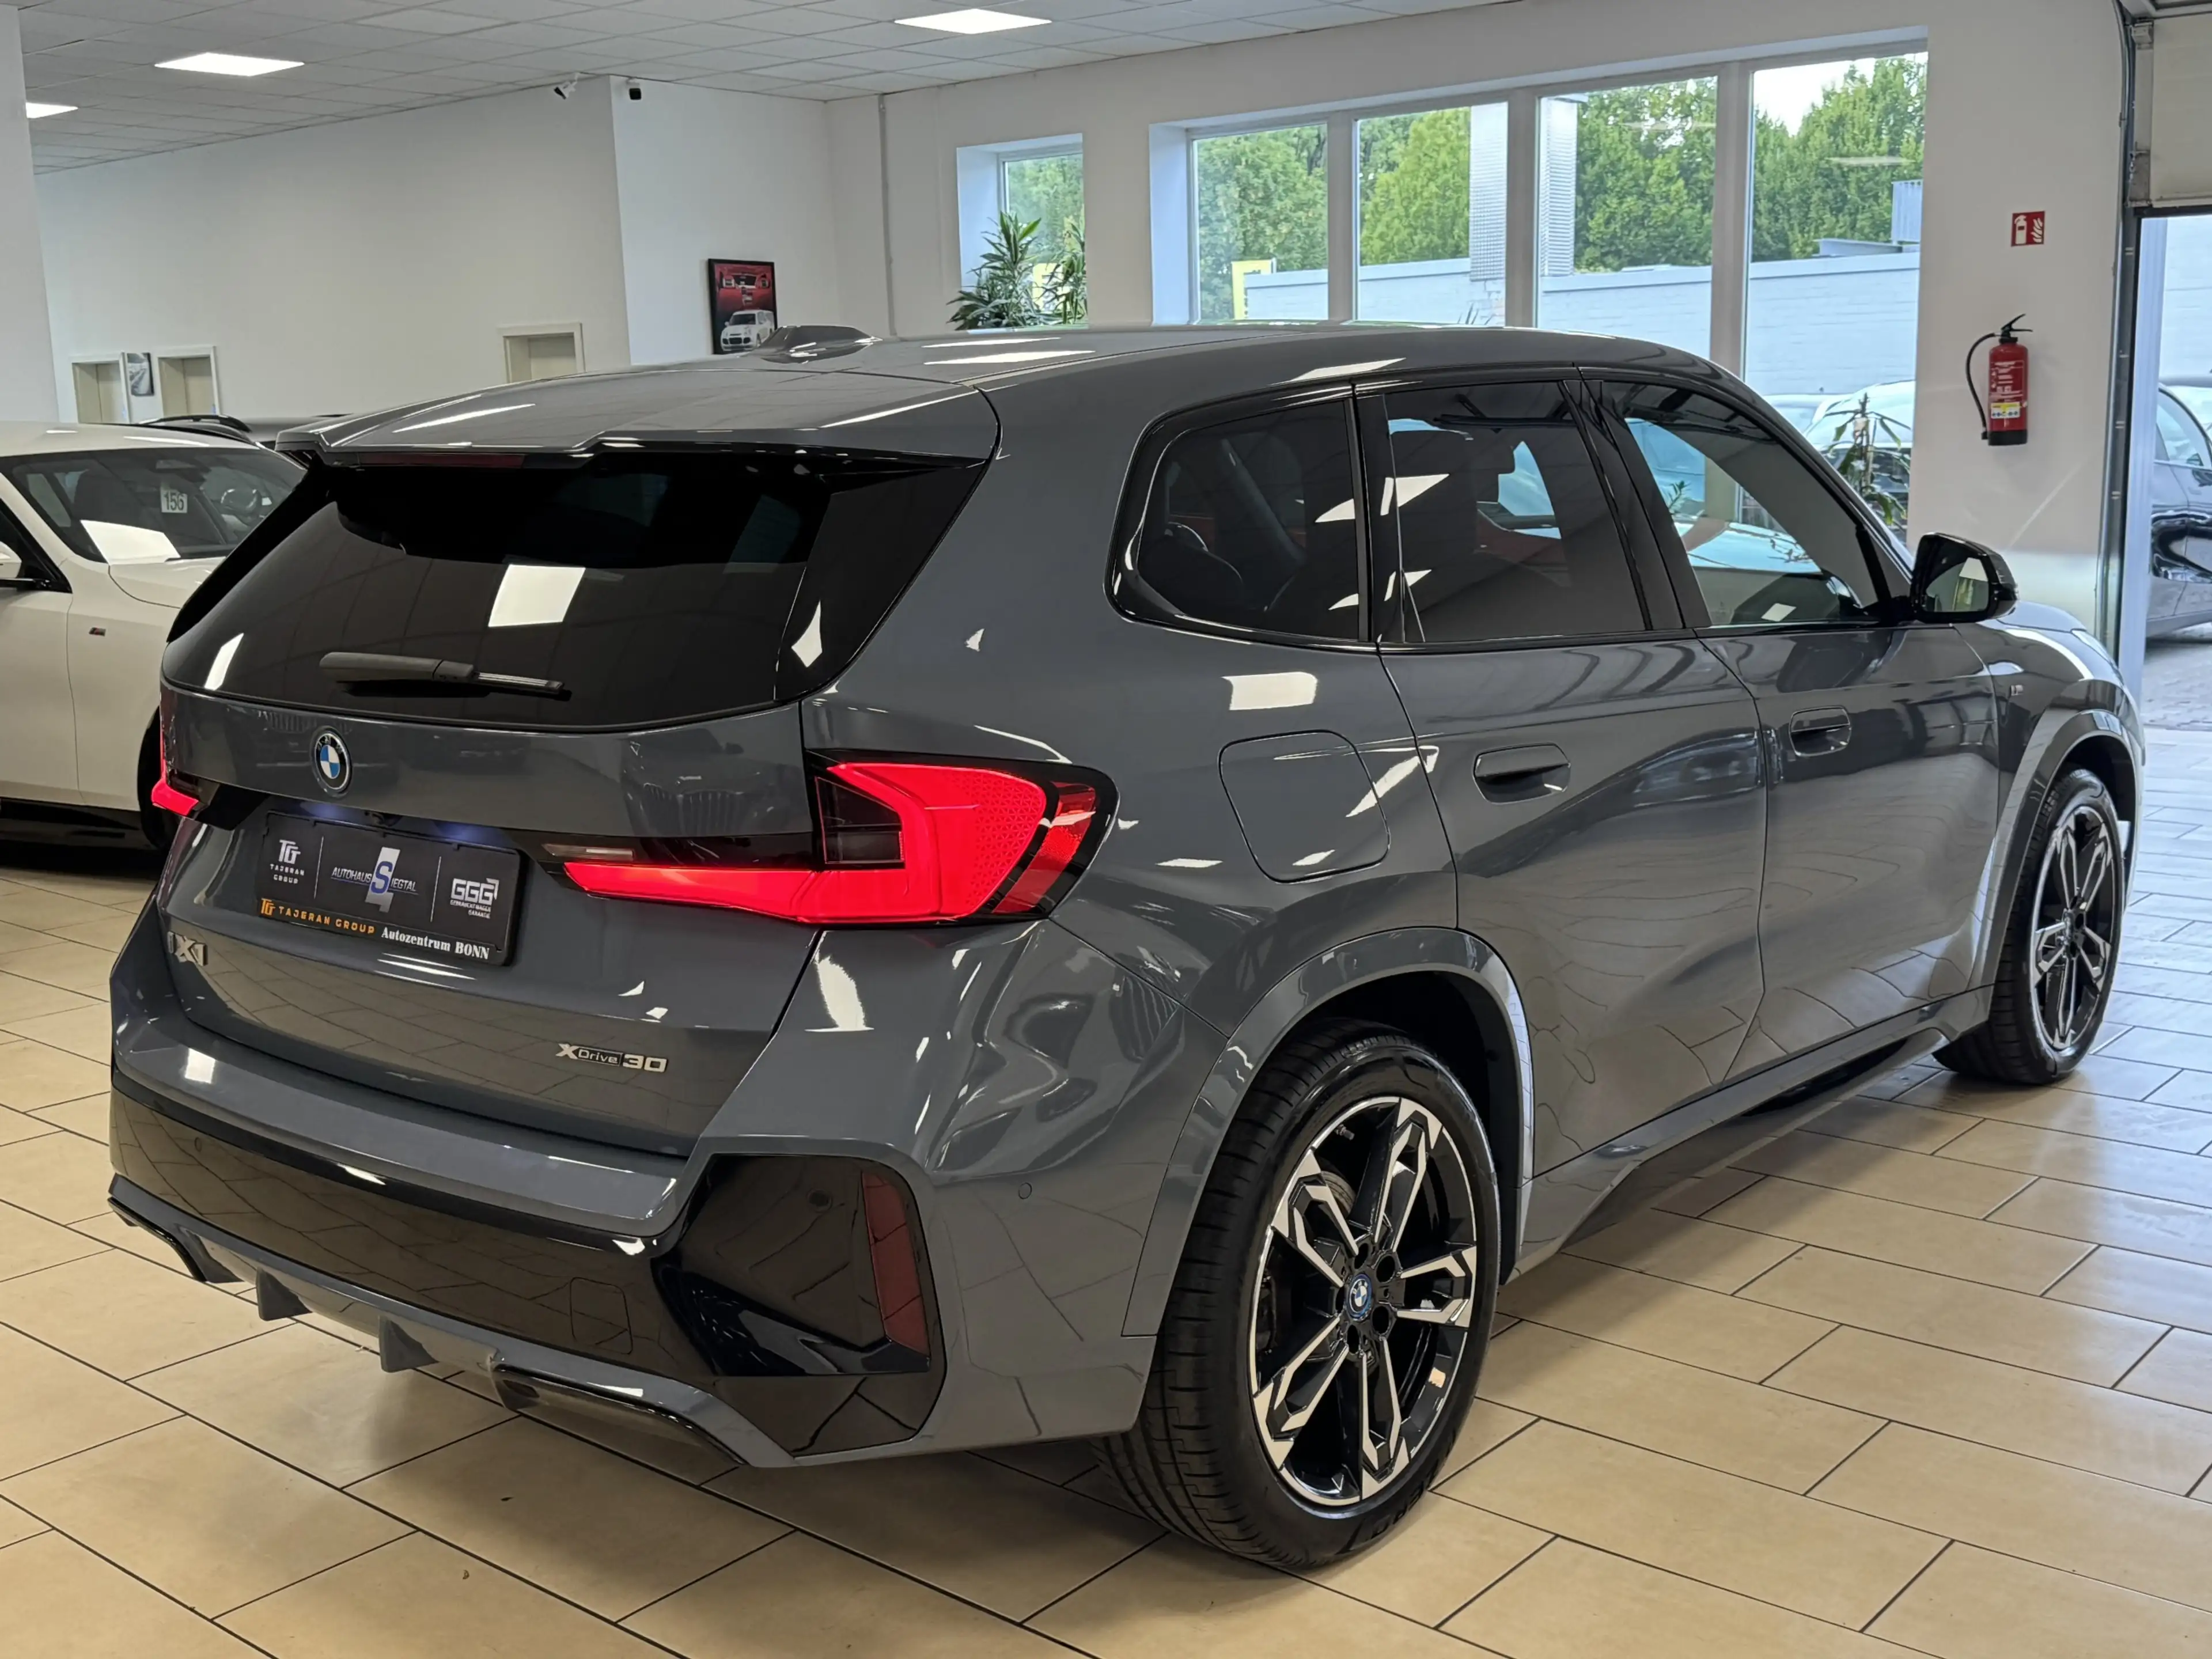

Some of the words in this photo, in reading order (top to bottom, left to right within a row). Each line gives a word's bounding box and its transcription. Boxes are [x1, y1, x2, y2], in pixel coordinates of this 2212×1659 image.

[164, 492, 184, 511] 156
[270, 863, 305, 876] TAJERAN
[332, 867, 372, 883] AUTOHAUS
[273, 874, 298, 884] GROUP
[451, 878, 494, 906] GGG
[279, 906, 331, 926] TAJERAN
[336, 918, 376, 934] GROUP
[381, 926, 451, 952] Autozentrum
[454, 941, 490, 960] BONN
